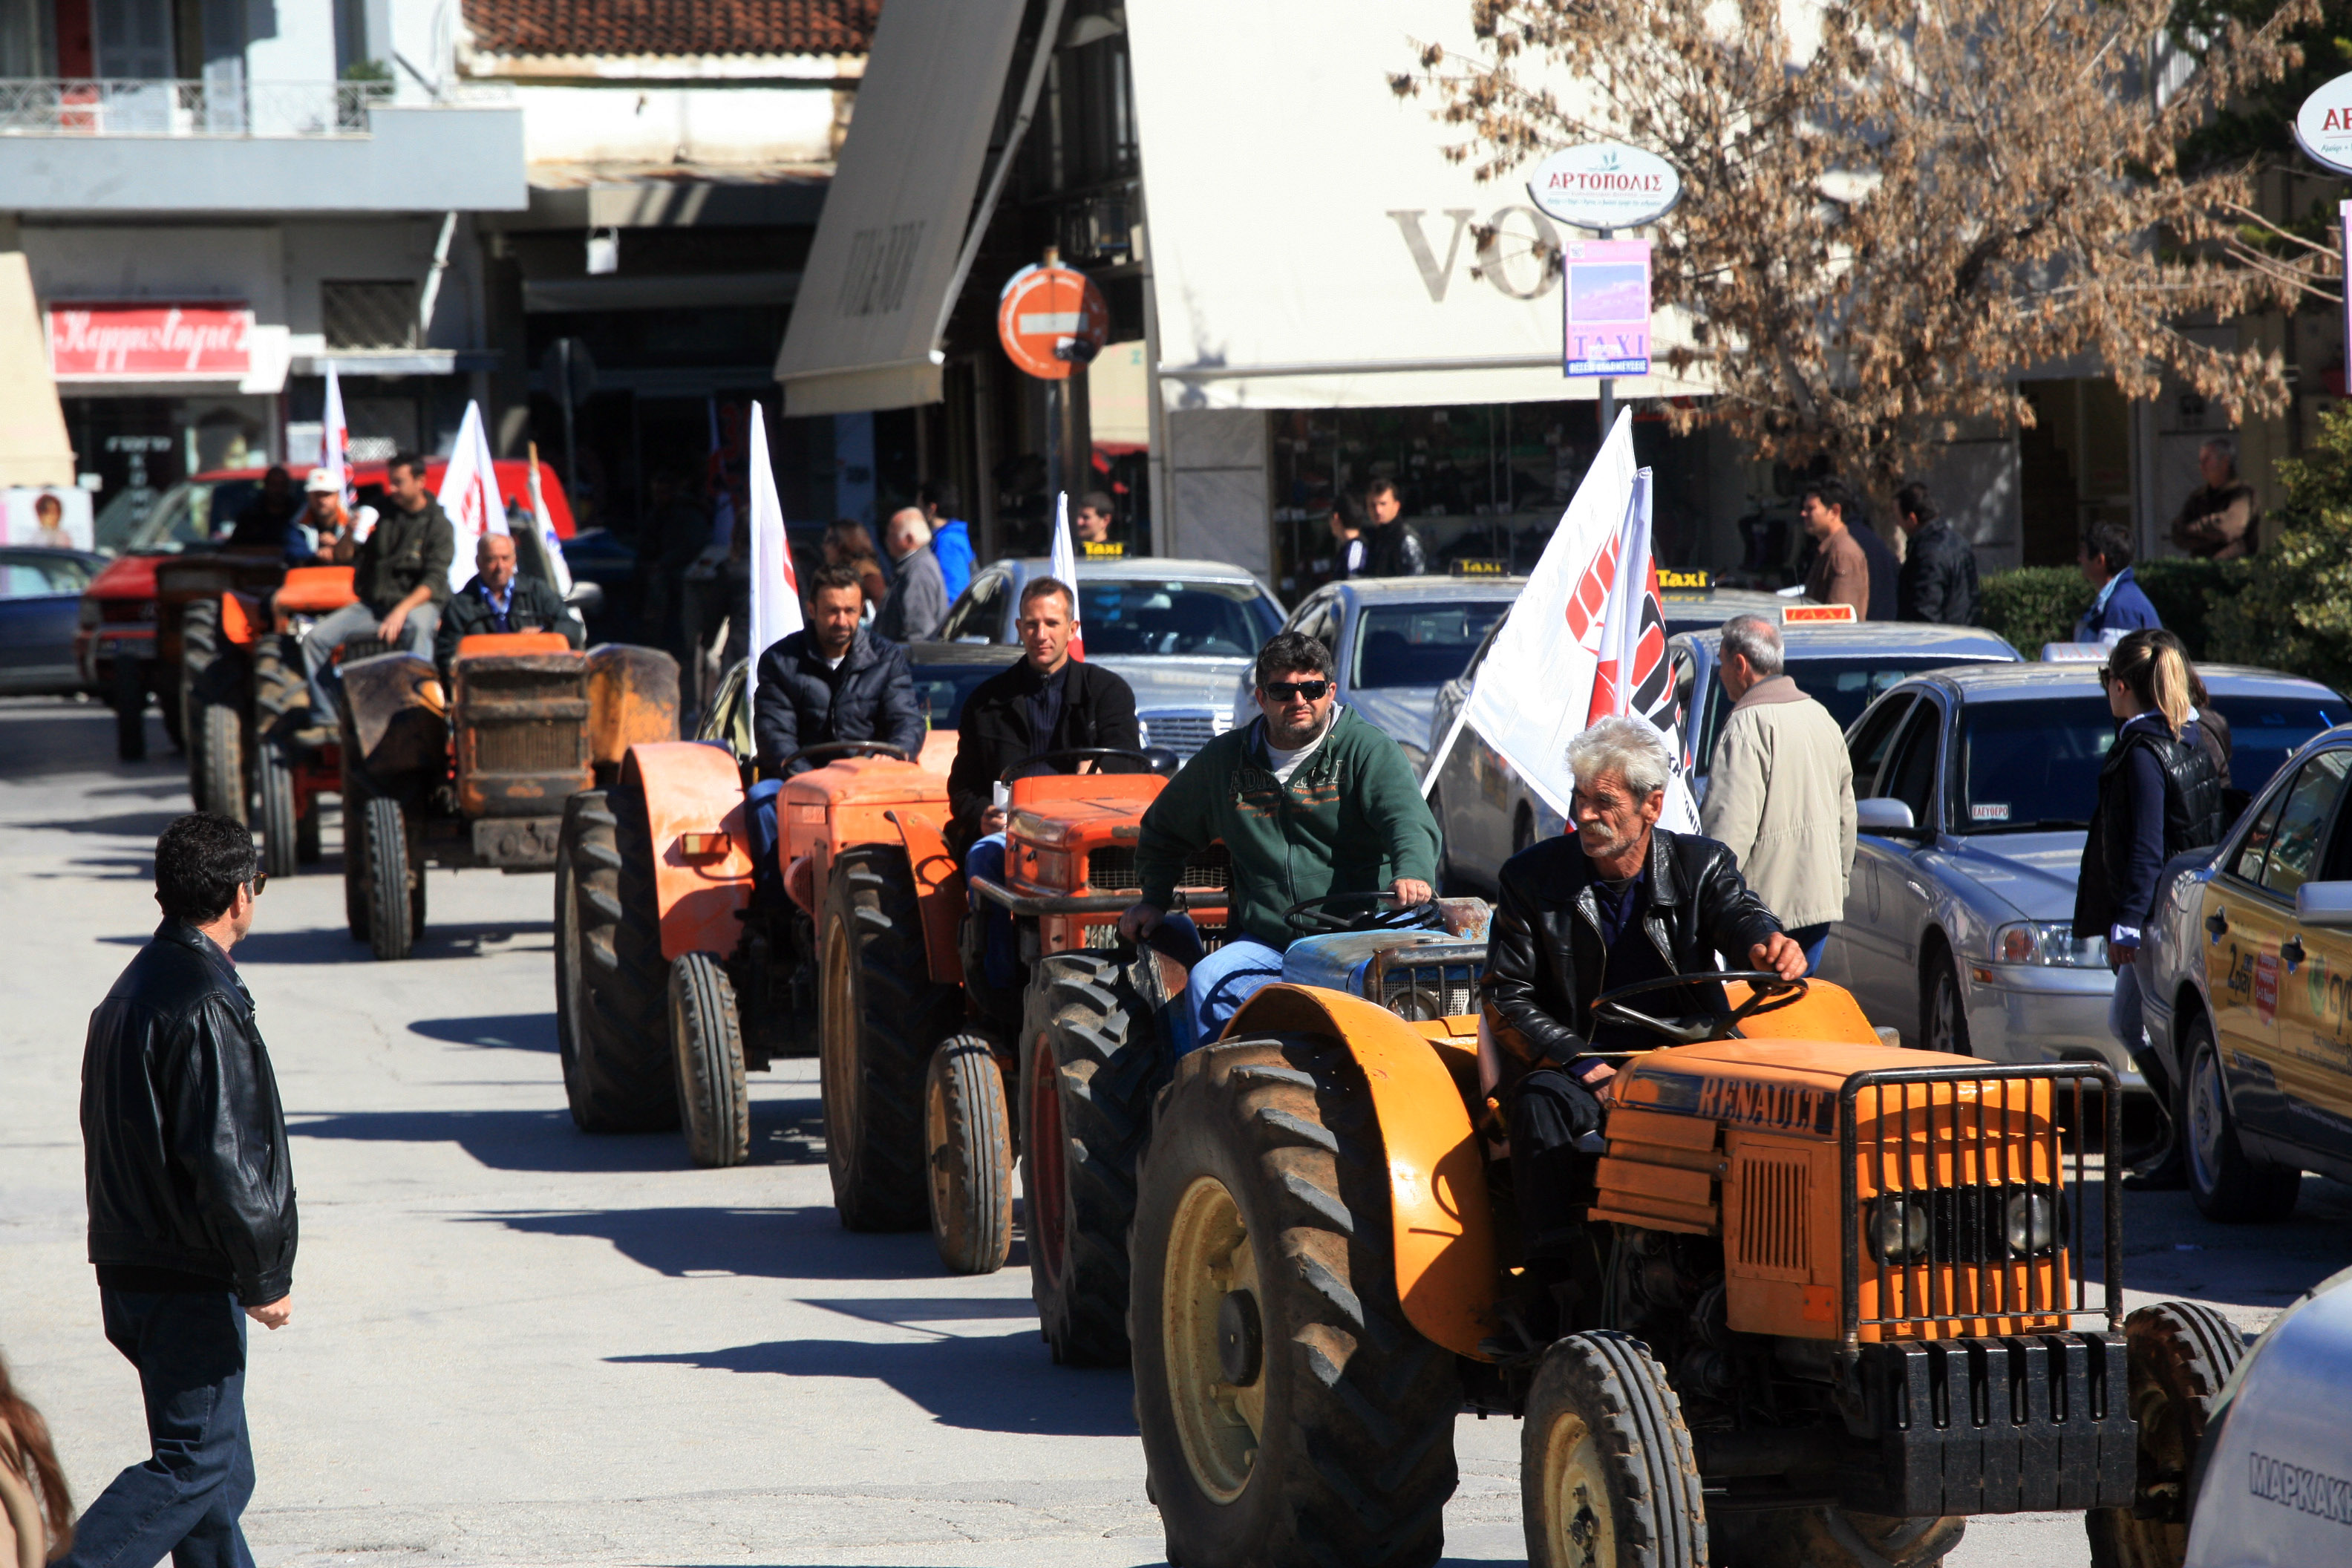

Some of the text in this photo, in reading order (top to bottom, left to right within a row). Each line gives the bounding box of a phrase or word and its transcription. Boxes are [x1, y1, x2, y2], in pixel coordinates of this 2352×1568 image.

[1549, 172, 1663, 192] ΑΡΤΟΠΟΛΙΣ
[1082, 541, 1124, 555] Taxi
[1460, 559, 1501, 572] Taxi
[1656, 569, 1708, 587] Taxi
[1789, 607, 1847, 621] TAXI
[1973, 806, 2008, 817] ΕΛΕΥΘΕΡΟ
[1699, 1077, 1824, 1128] RENAULT
